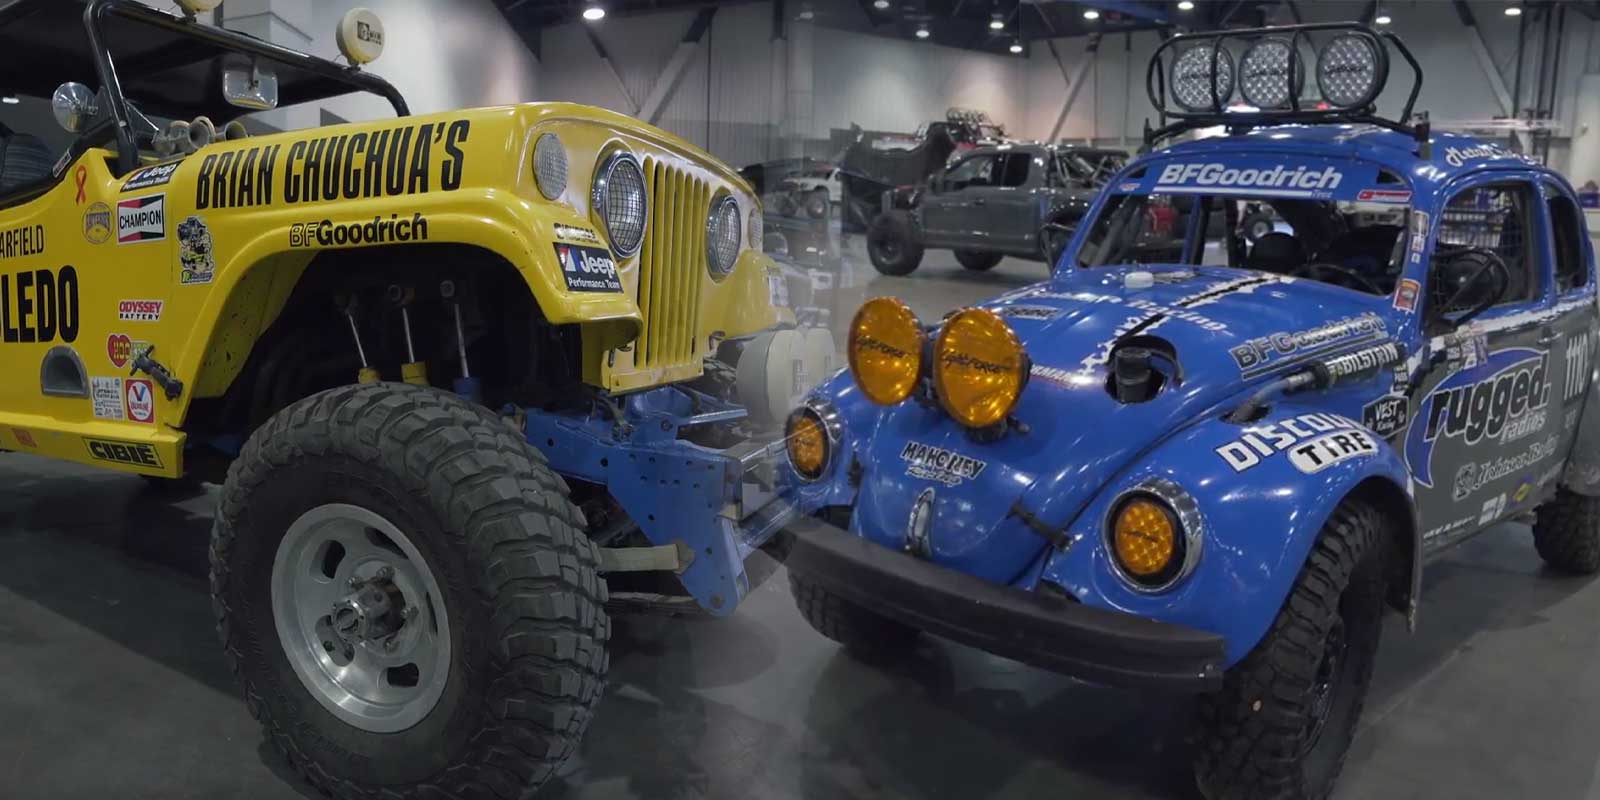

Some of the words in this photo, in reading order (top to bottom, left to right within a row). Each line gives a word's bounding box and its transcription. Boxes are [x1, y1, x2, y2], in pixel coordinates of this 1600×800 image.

[196, 144, 281, 210] BRIAN
[283, 119, 471, 204] CHUCHUA'S
[1157, 162, 1343, 190] BFGoodrich
[119, 209, 161, 230] CHAMPION
[289, 212, 428, 247] BFGoodrich
[580, 250, 615, 279] Jeep
[119, 301, 162, 313] ODYSSEY
[119, 313, 160, 321] BATTERY
[901, 441, 985, 479] MAHONEY
[1296, 432, 1372, 466] TIRE
